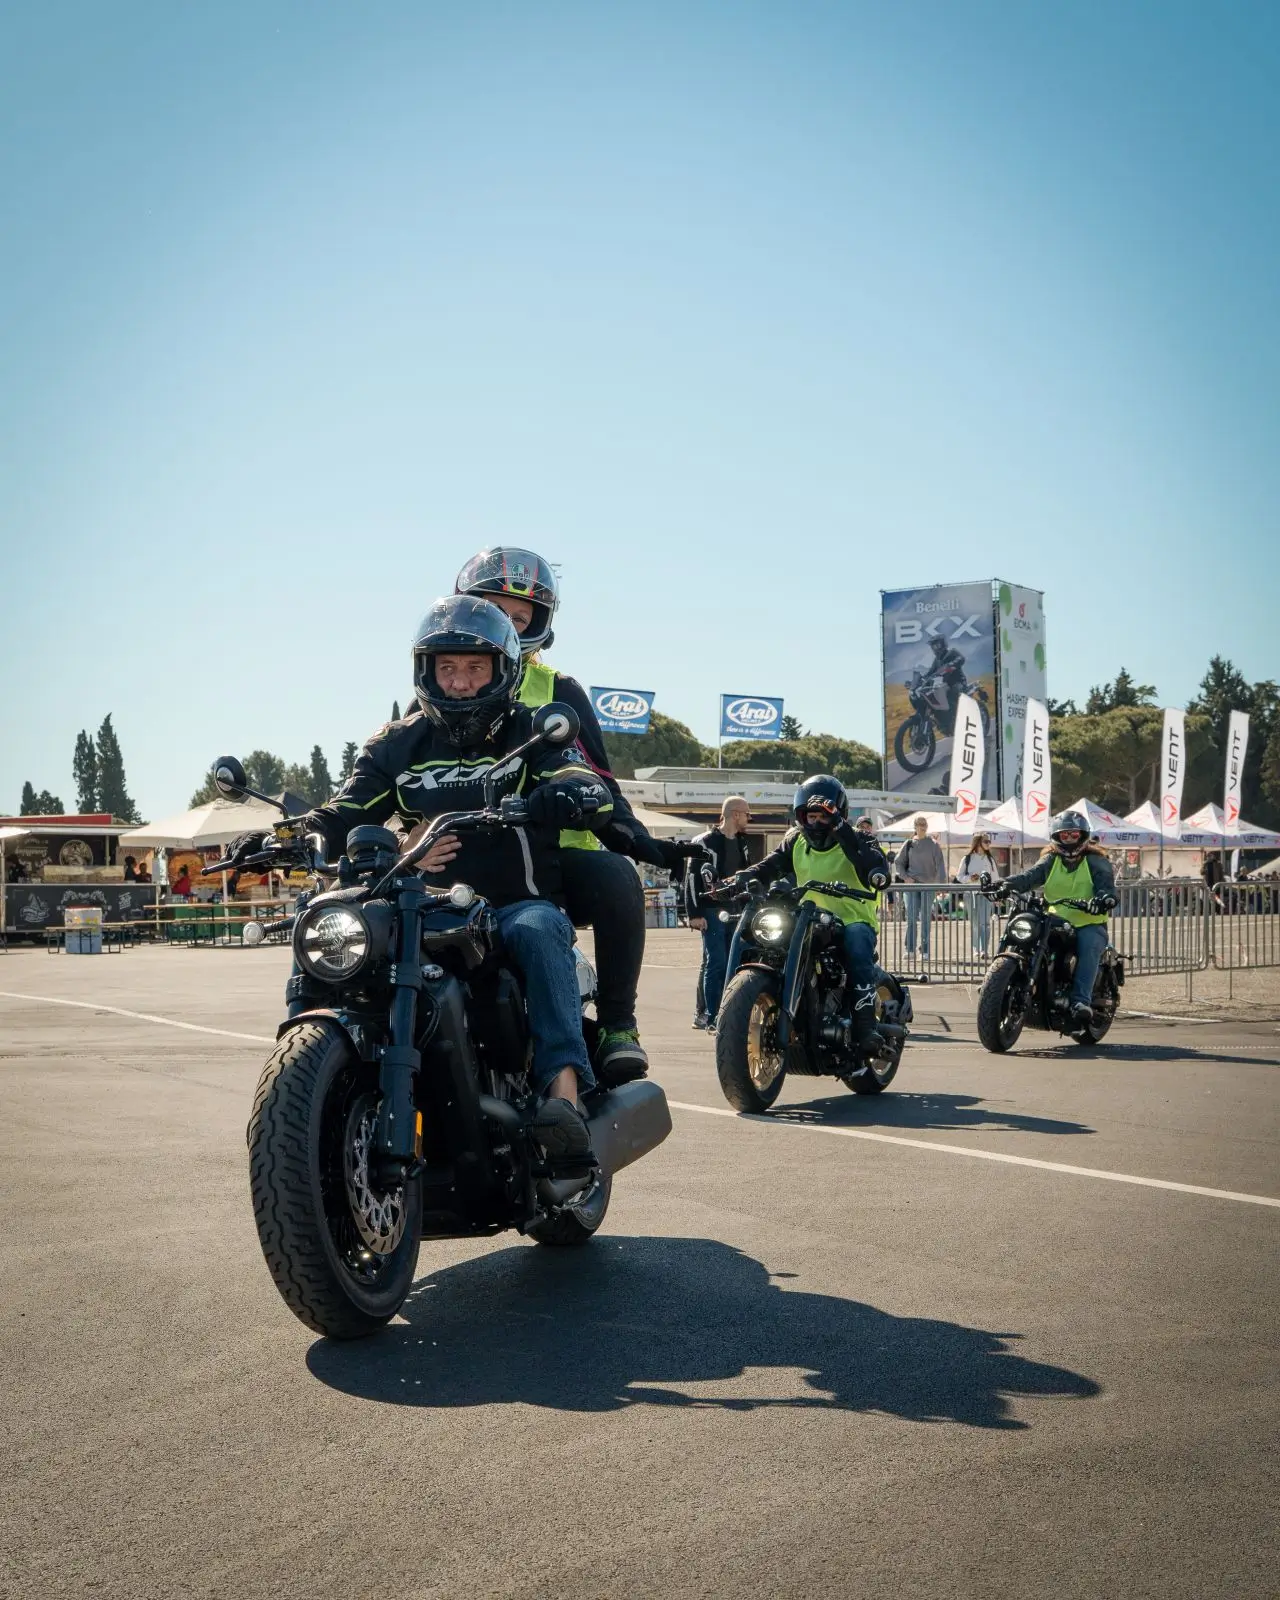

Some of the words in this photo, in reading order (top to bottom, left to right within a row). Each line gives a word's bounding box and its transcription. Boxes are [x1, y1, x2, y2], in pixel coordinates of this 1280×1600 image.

[916, 599, 960, 613] Benelli
[895, 614, 982, 644] BKX
[601, 695, 642, 714] Arai
[731, 702, 772, 720] Arai
[961, 716, 977, 783] VENT
[1033, 719, 1043, 784] VENT
[1167, 726, 1179, 789] VENT
[1229, 729, 1240, 791] VENT
[1115, 832, 1140, 841] VENT
[1181, 834, 1204, 844] VENT
[1243, 834, 1266, 844] VENT
